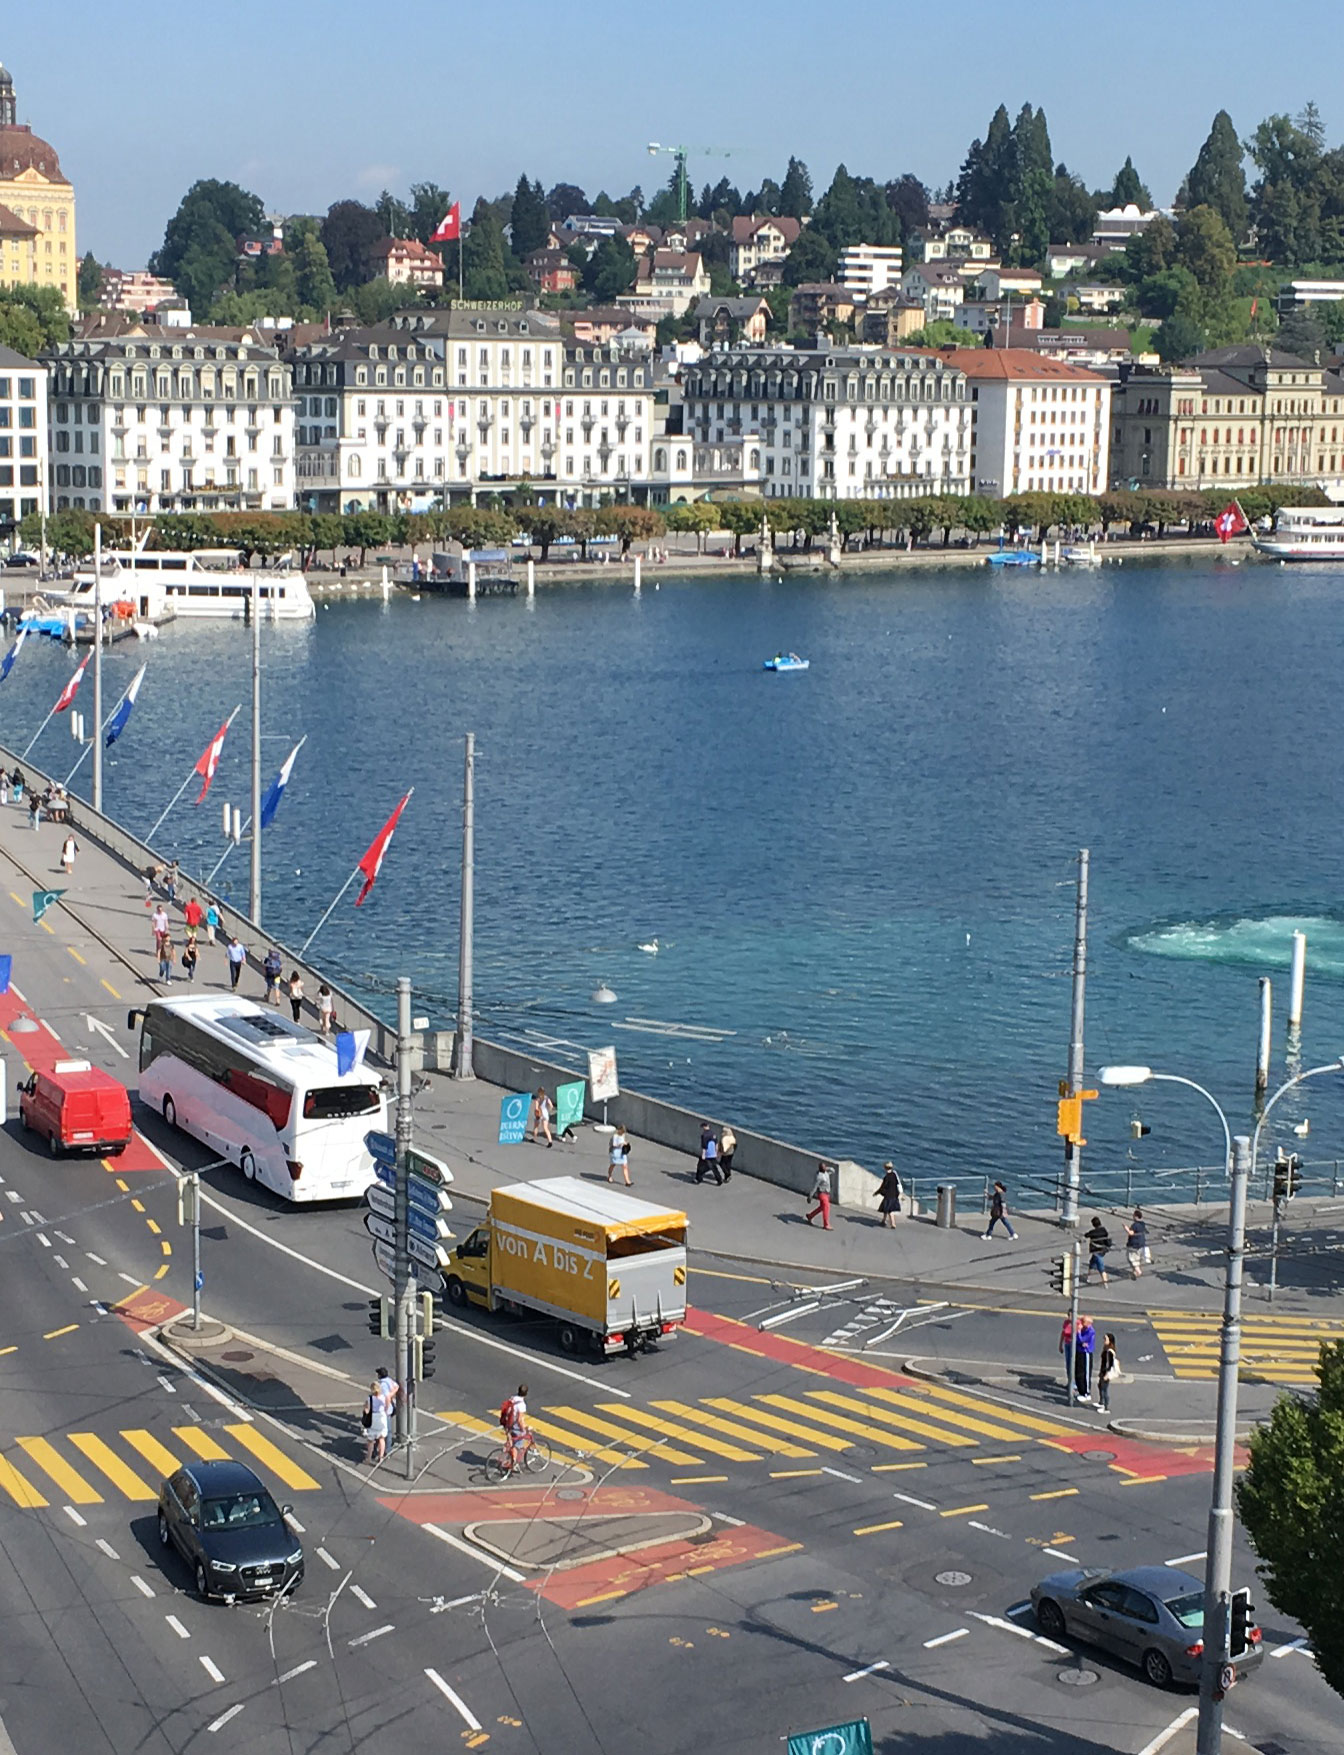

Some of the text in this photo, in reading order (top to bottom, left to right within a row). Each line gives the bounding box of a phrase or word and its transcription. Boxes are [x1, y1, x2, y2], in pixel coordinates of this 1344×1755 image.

[451, 299, 522, 311] SCHWEIZERHOF
[497, 1232, 594, 1281] von A bis Z
